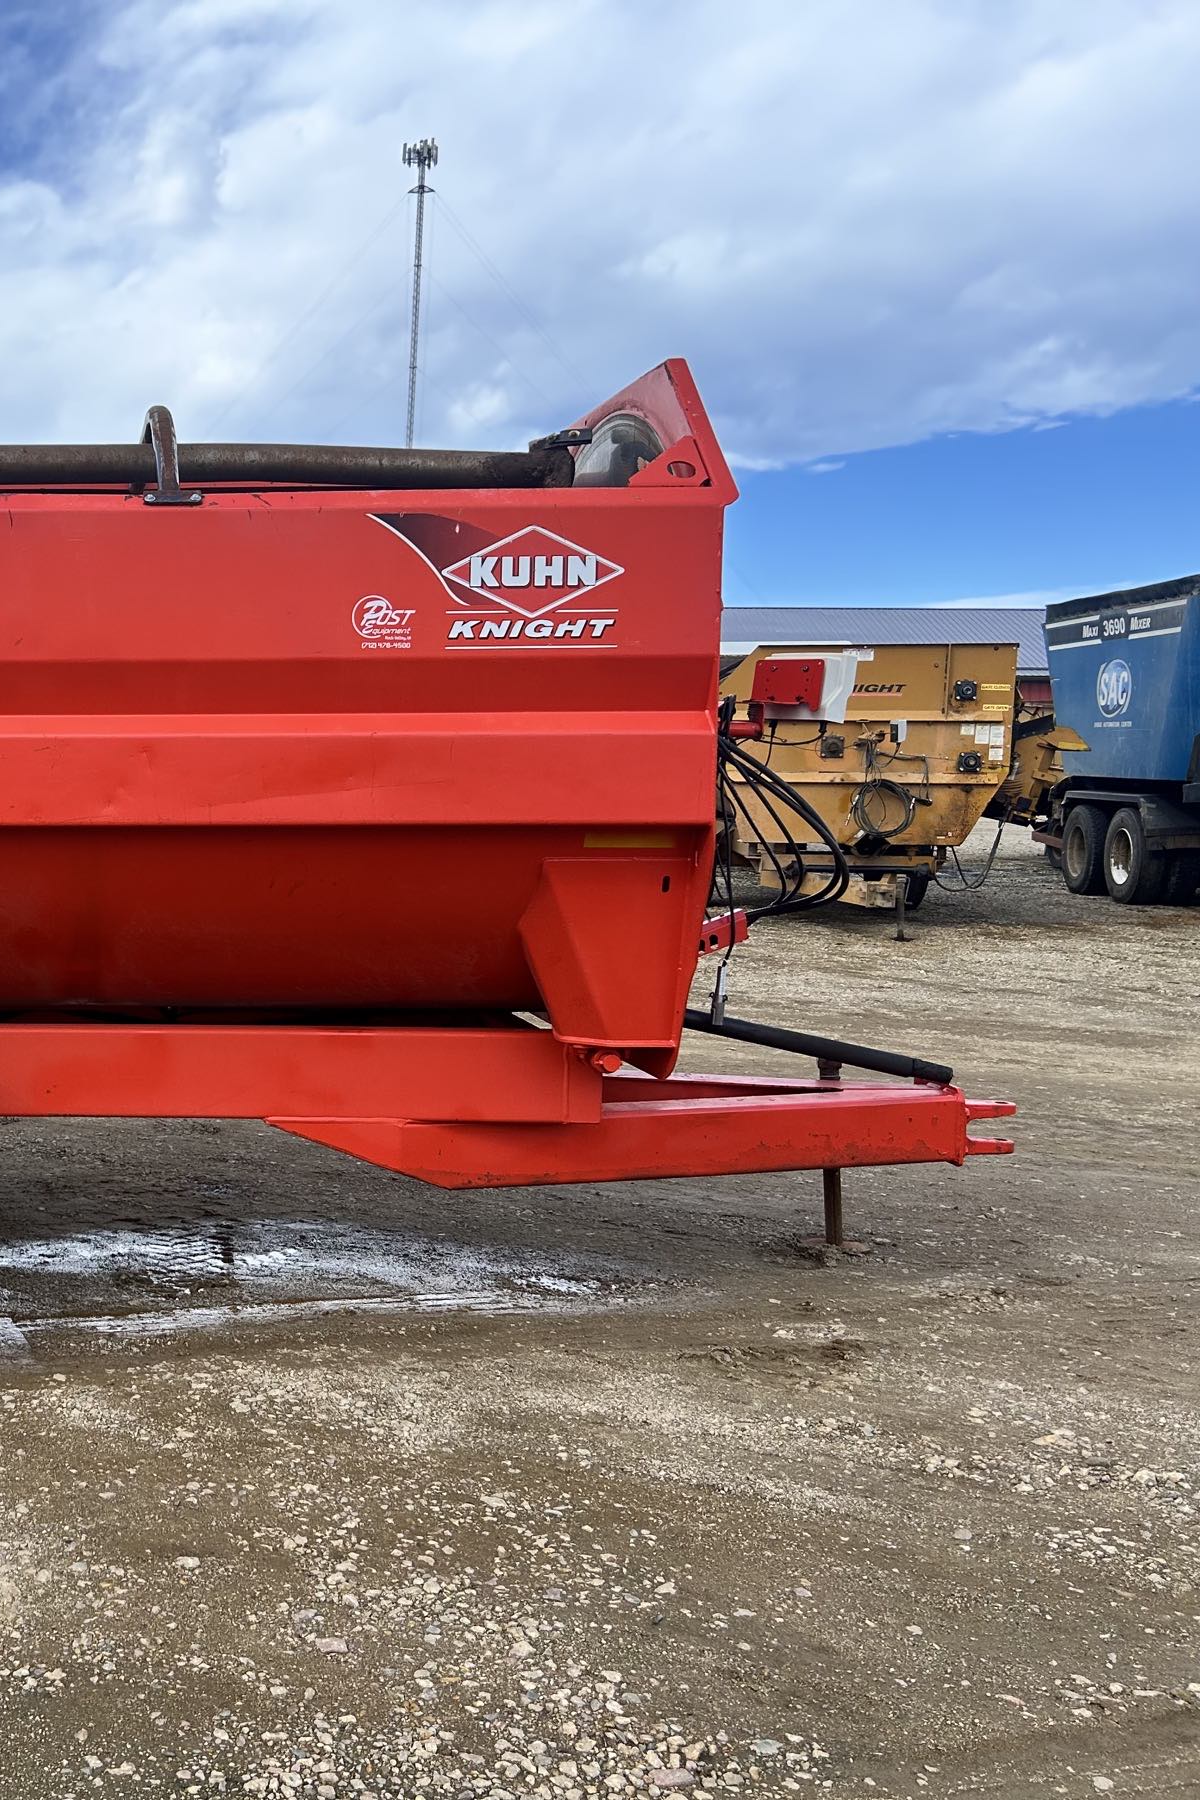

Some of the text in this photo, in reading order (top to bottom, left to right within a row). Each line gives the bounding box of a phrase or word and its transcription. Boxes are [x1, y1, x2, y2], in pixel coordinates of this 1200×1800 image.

[469, 555, 597, 588] KUHN
[360, 600, 417, 626] POST
[448, 619, 615, 639] KNIGHT
[1103, 617, 1126, 637] 3690
[1100, 670, 1128, 706] SAC
